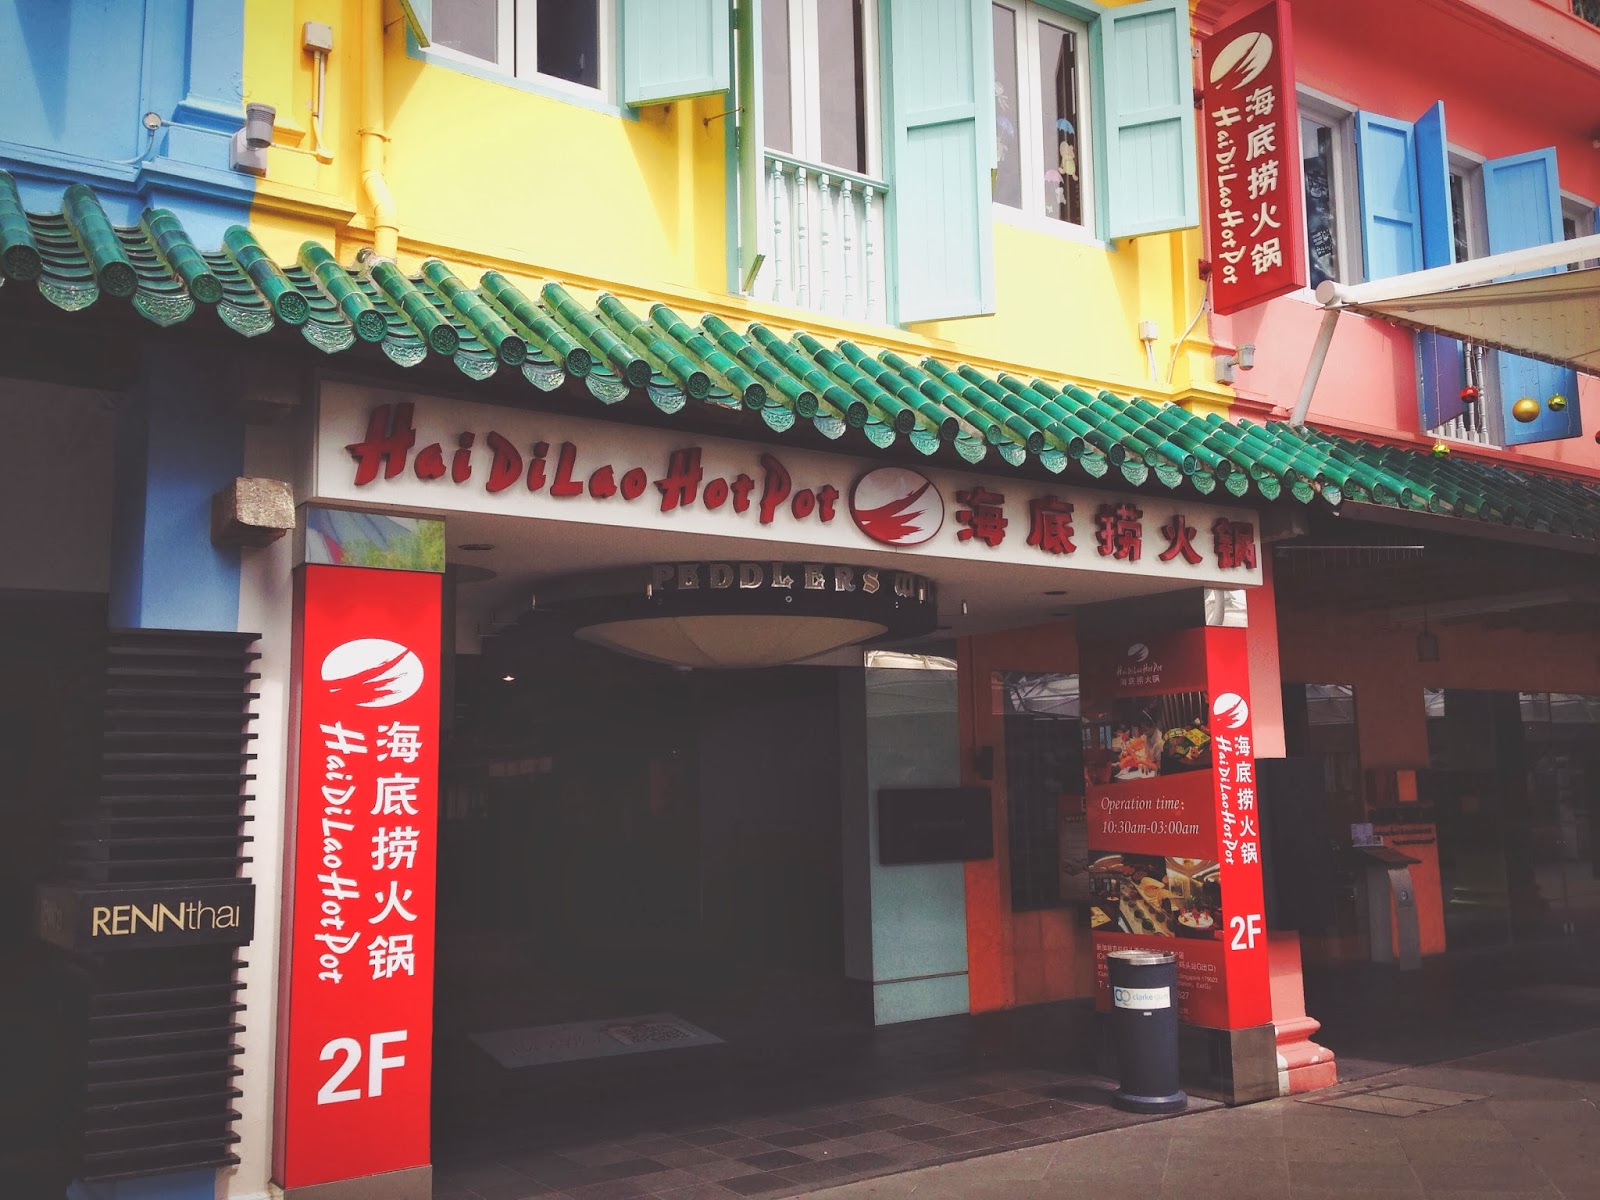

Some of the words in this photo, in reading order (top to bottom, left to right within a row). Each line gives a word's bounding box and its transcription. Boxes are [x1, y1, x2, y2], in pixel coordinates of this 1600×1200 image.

[1245, 85, 1283, 276] 海底捞火锅
[956, 486, 1258, 570] 海底捞火锅
[652, 561, 880, 593] PEDDLERS
[1100, 796, 1152, 815] Operation
[1156, 796, 1186, 811] time:
[1102, 820, 1200, 835] 10:30am-03:00am
[1234, 735, 1258, 864] 海底捞火锅
[367, 723, 422, 980] 海底捞火锅
[1229, 913, 1262, 951] 2F
[1132, 993, 1153, 1001] clarke
[317, 1029, 409, 1106] 2F
